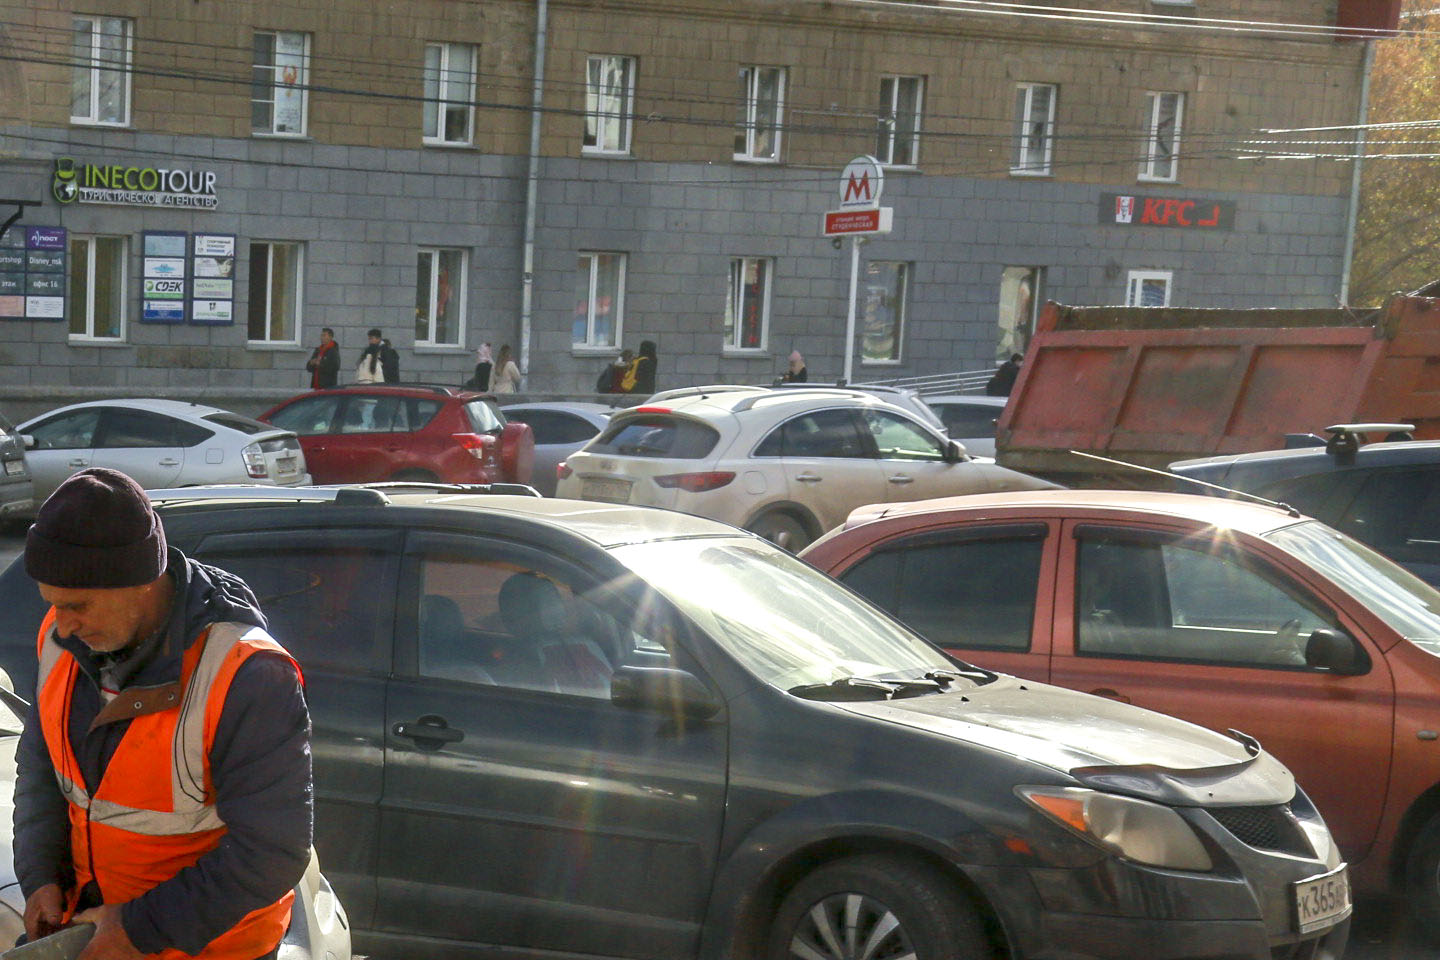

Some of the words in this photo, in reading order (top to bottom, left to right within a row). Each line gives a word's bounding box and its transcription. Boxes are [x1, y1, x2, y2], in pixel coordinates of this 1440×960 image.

[85, 164, 216, 193] INECOTOUR
[82, 190, 160, 204] ТУРИСТИЧЕСКОЕ
[165, 195, 219, 207] АГЕНТСТВО
[1141, 198, 1195, 226] KFC
[156, 281, 183, 292] CDEK
